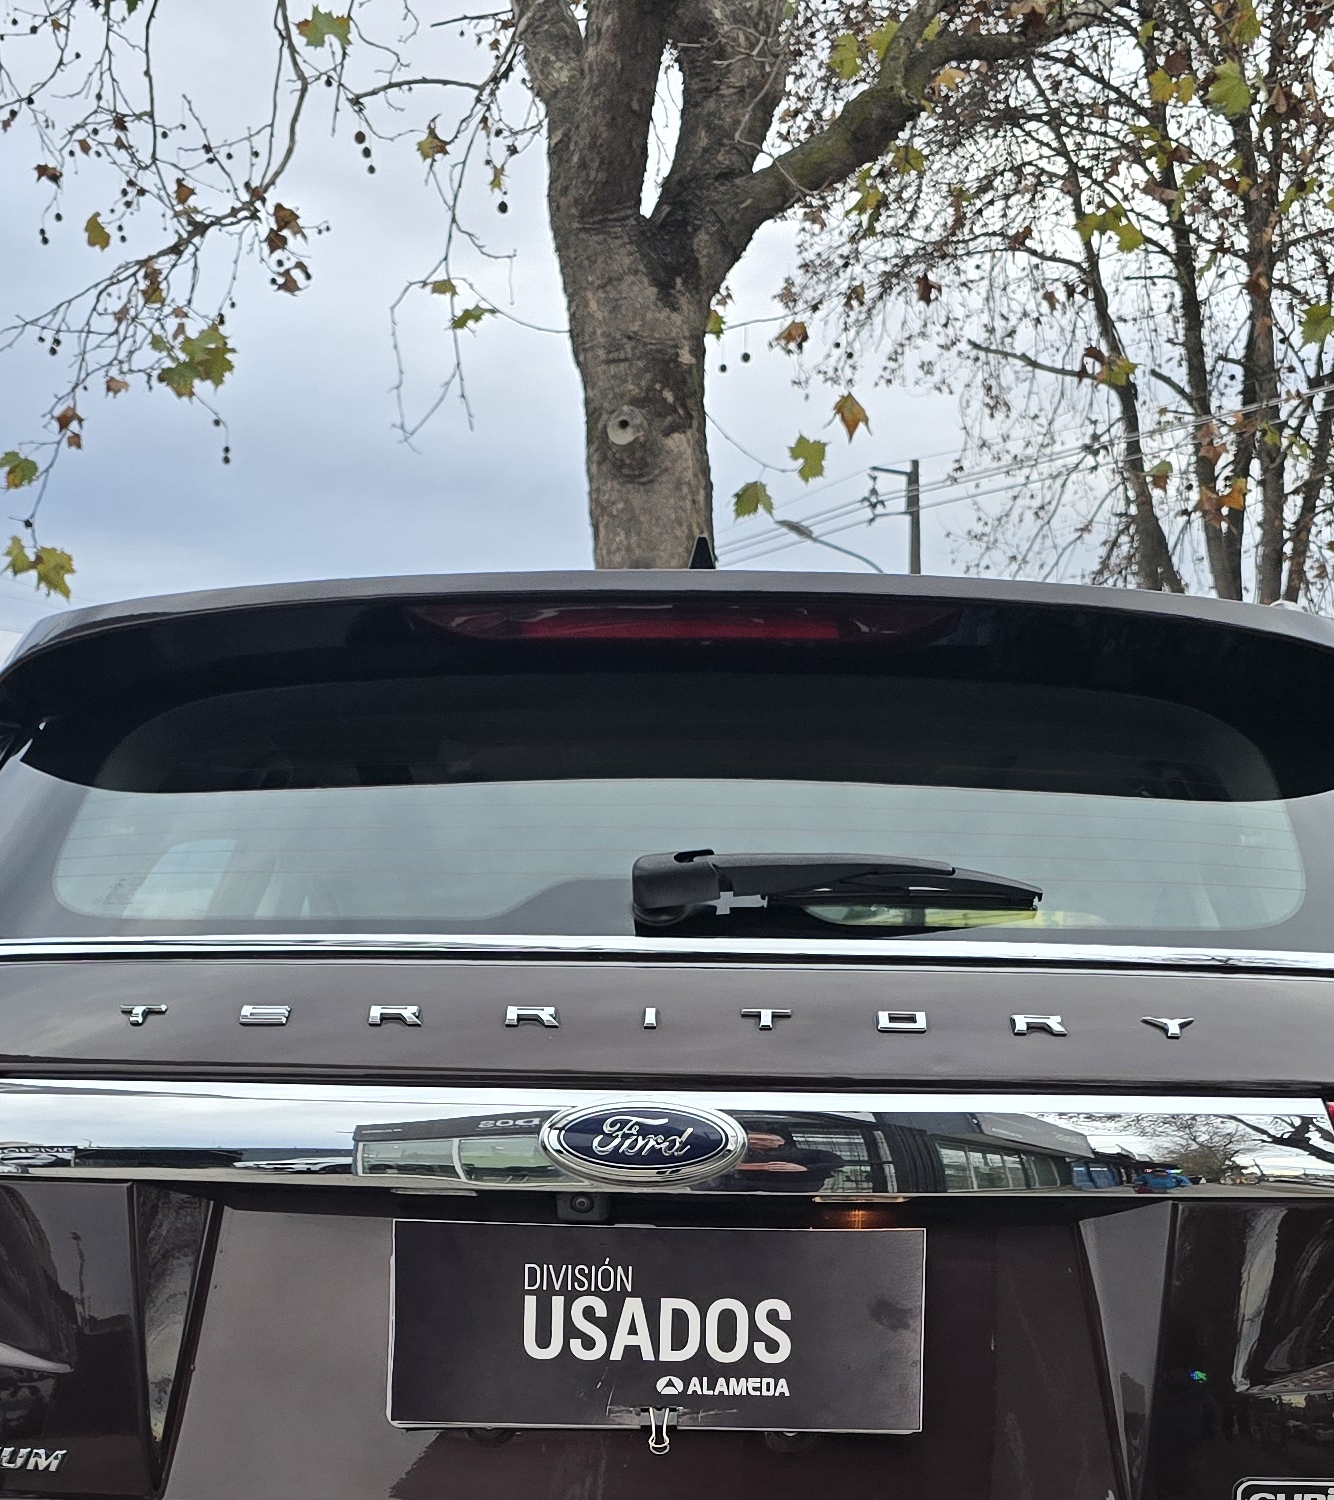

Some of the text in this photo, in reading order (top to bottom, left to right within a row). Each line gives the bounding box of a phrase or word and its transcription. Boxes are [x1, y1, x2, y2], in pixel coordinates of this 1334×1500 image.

[119, 1003, 1195, 1039] TERRITORY
[592, 1115, 694, 1156] Ford
[523, 1257, 634, 1292] DIVISIÓN
[523, 1295, 793, 1364] USADOS
[687, 1376, 790, 1397] ALAMEDA
